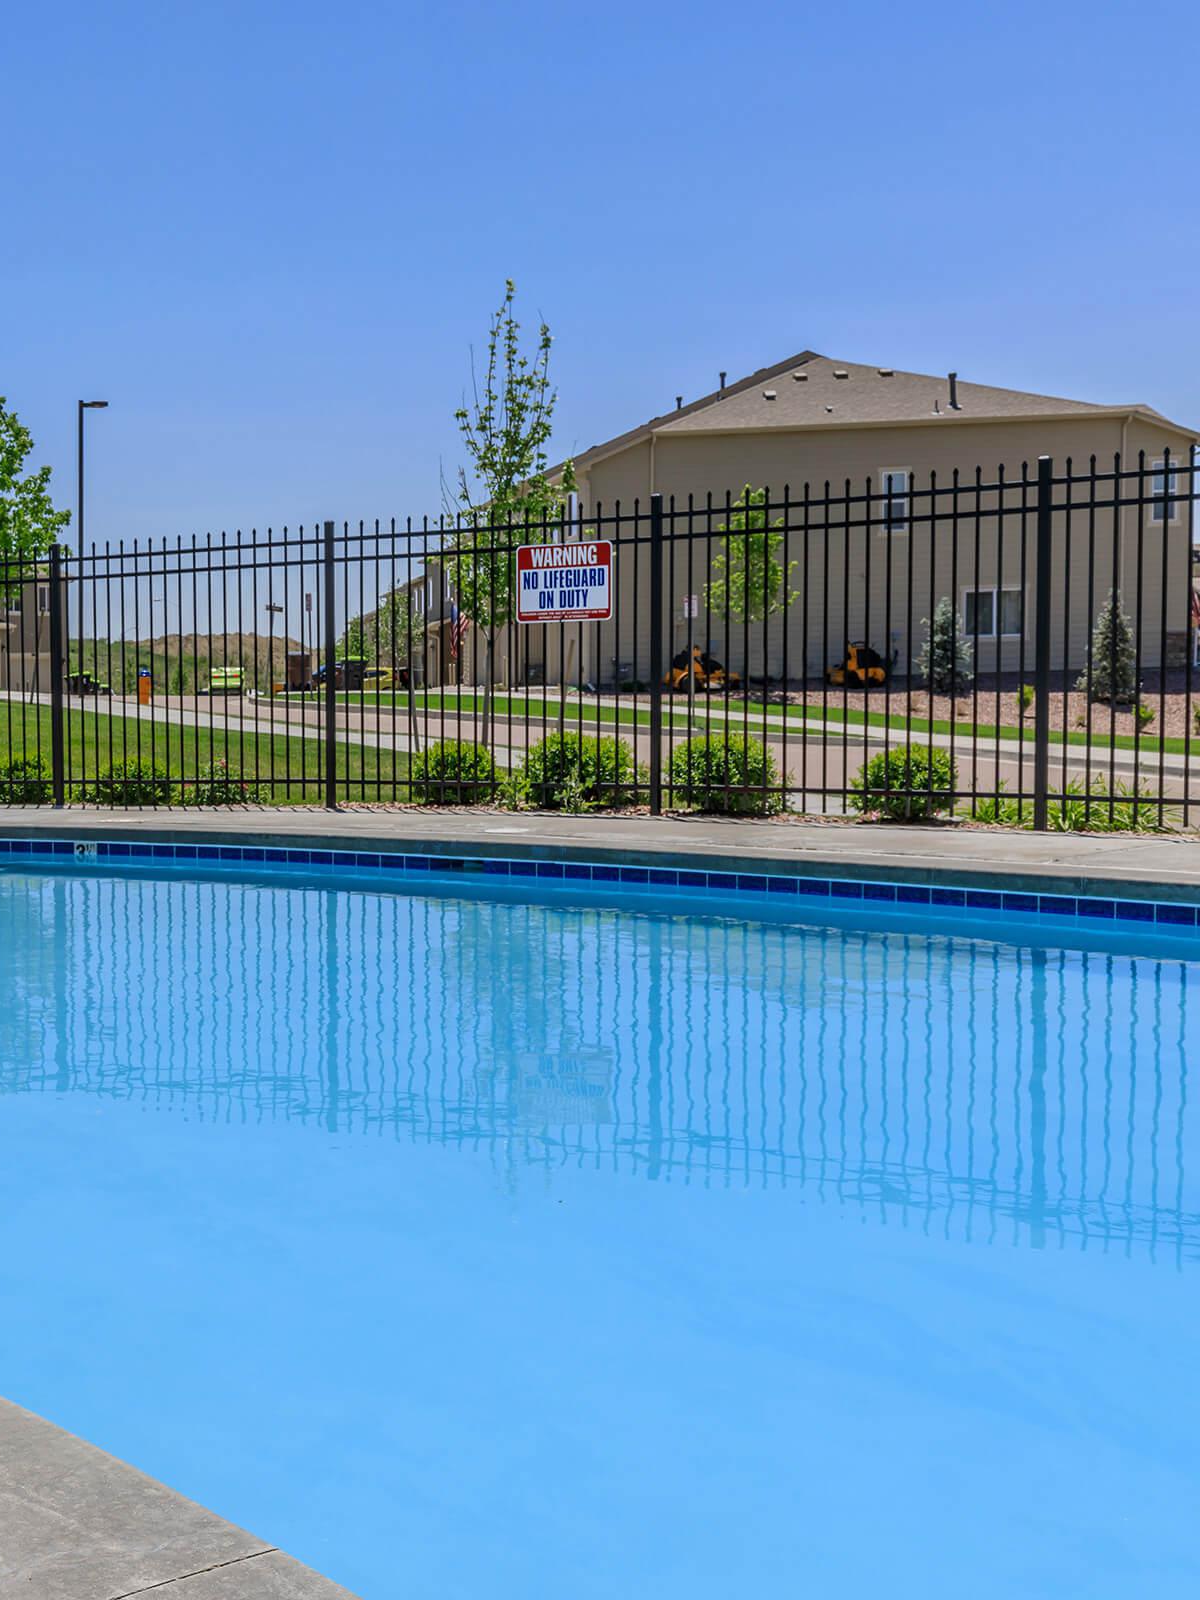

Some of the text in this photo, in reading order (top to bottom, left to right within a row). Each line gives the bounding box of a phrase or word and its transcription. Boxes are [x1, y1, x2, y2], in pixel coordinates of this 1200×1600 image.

[531, 545, 598, 568] WARNING
[523, 568, 605, 590] NO LIFEGUARD
[539, 589, 588, 609] ON DUTY
